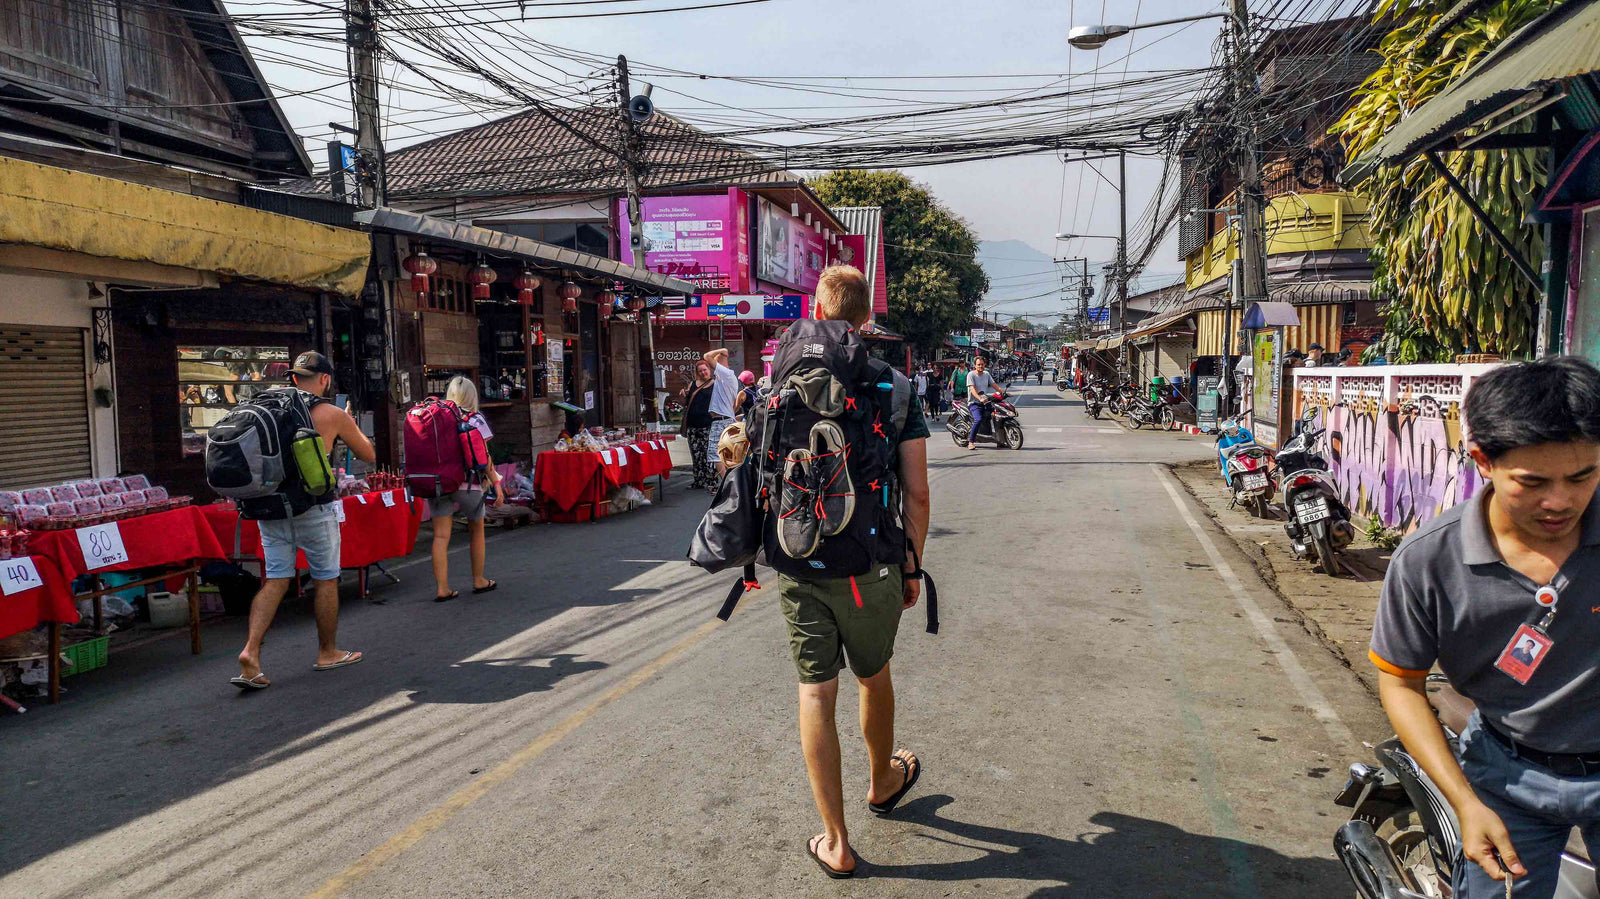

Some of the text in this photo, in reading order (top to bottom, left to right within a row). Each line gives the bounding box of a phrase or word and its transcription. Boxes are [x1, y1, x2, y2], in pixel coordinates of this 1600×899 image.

[666, 262, 701, 276] Pink
[689, 279, 718, 288] ARE
[657, 347, 701, 360] ออมสิน
[1303, 512, 1324, 522] 9861
[89, 530, 112, 557] 80
